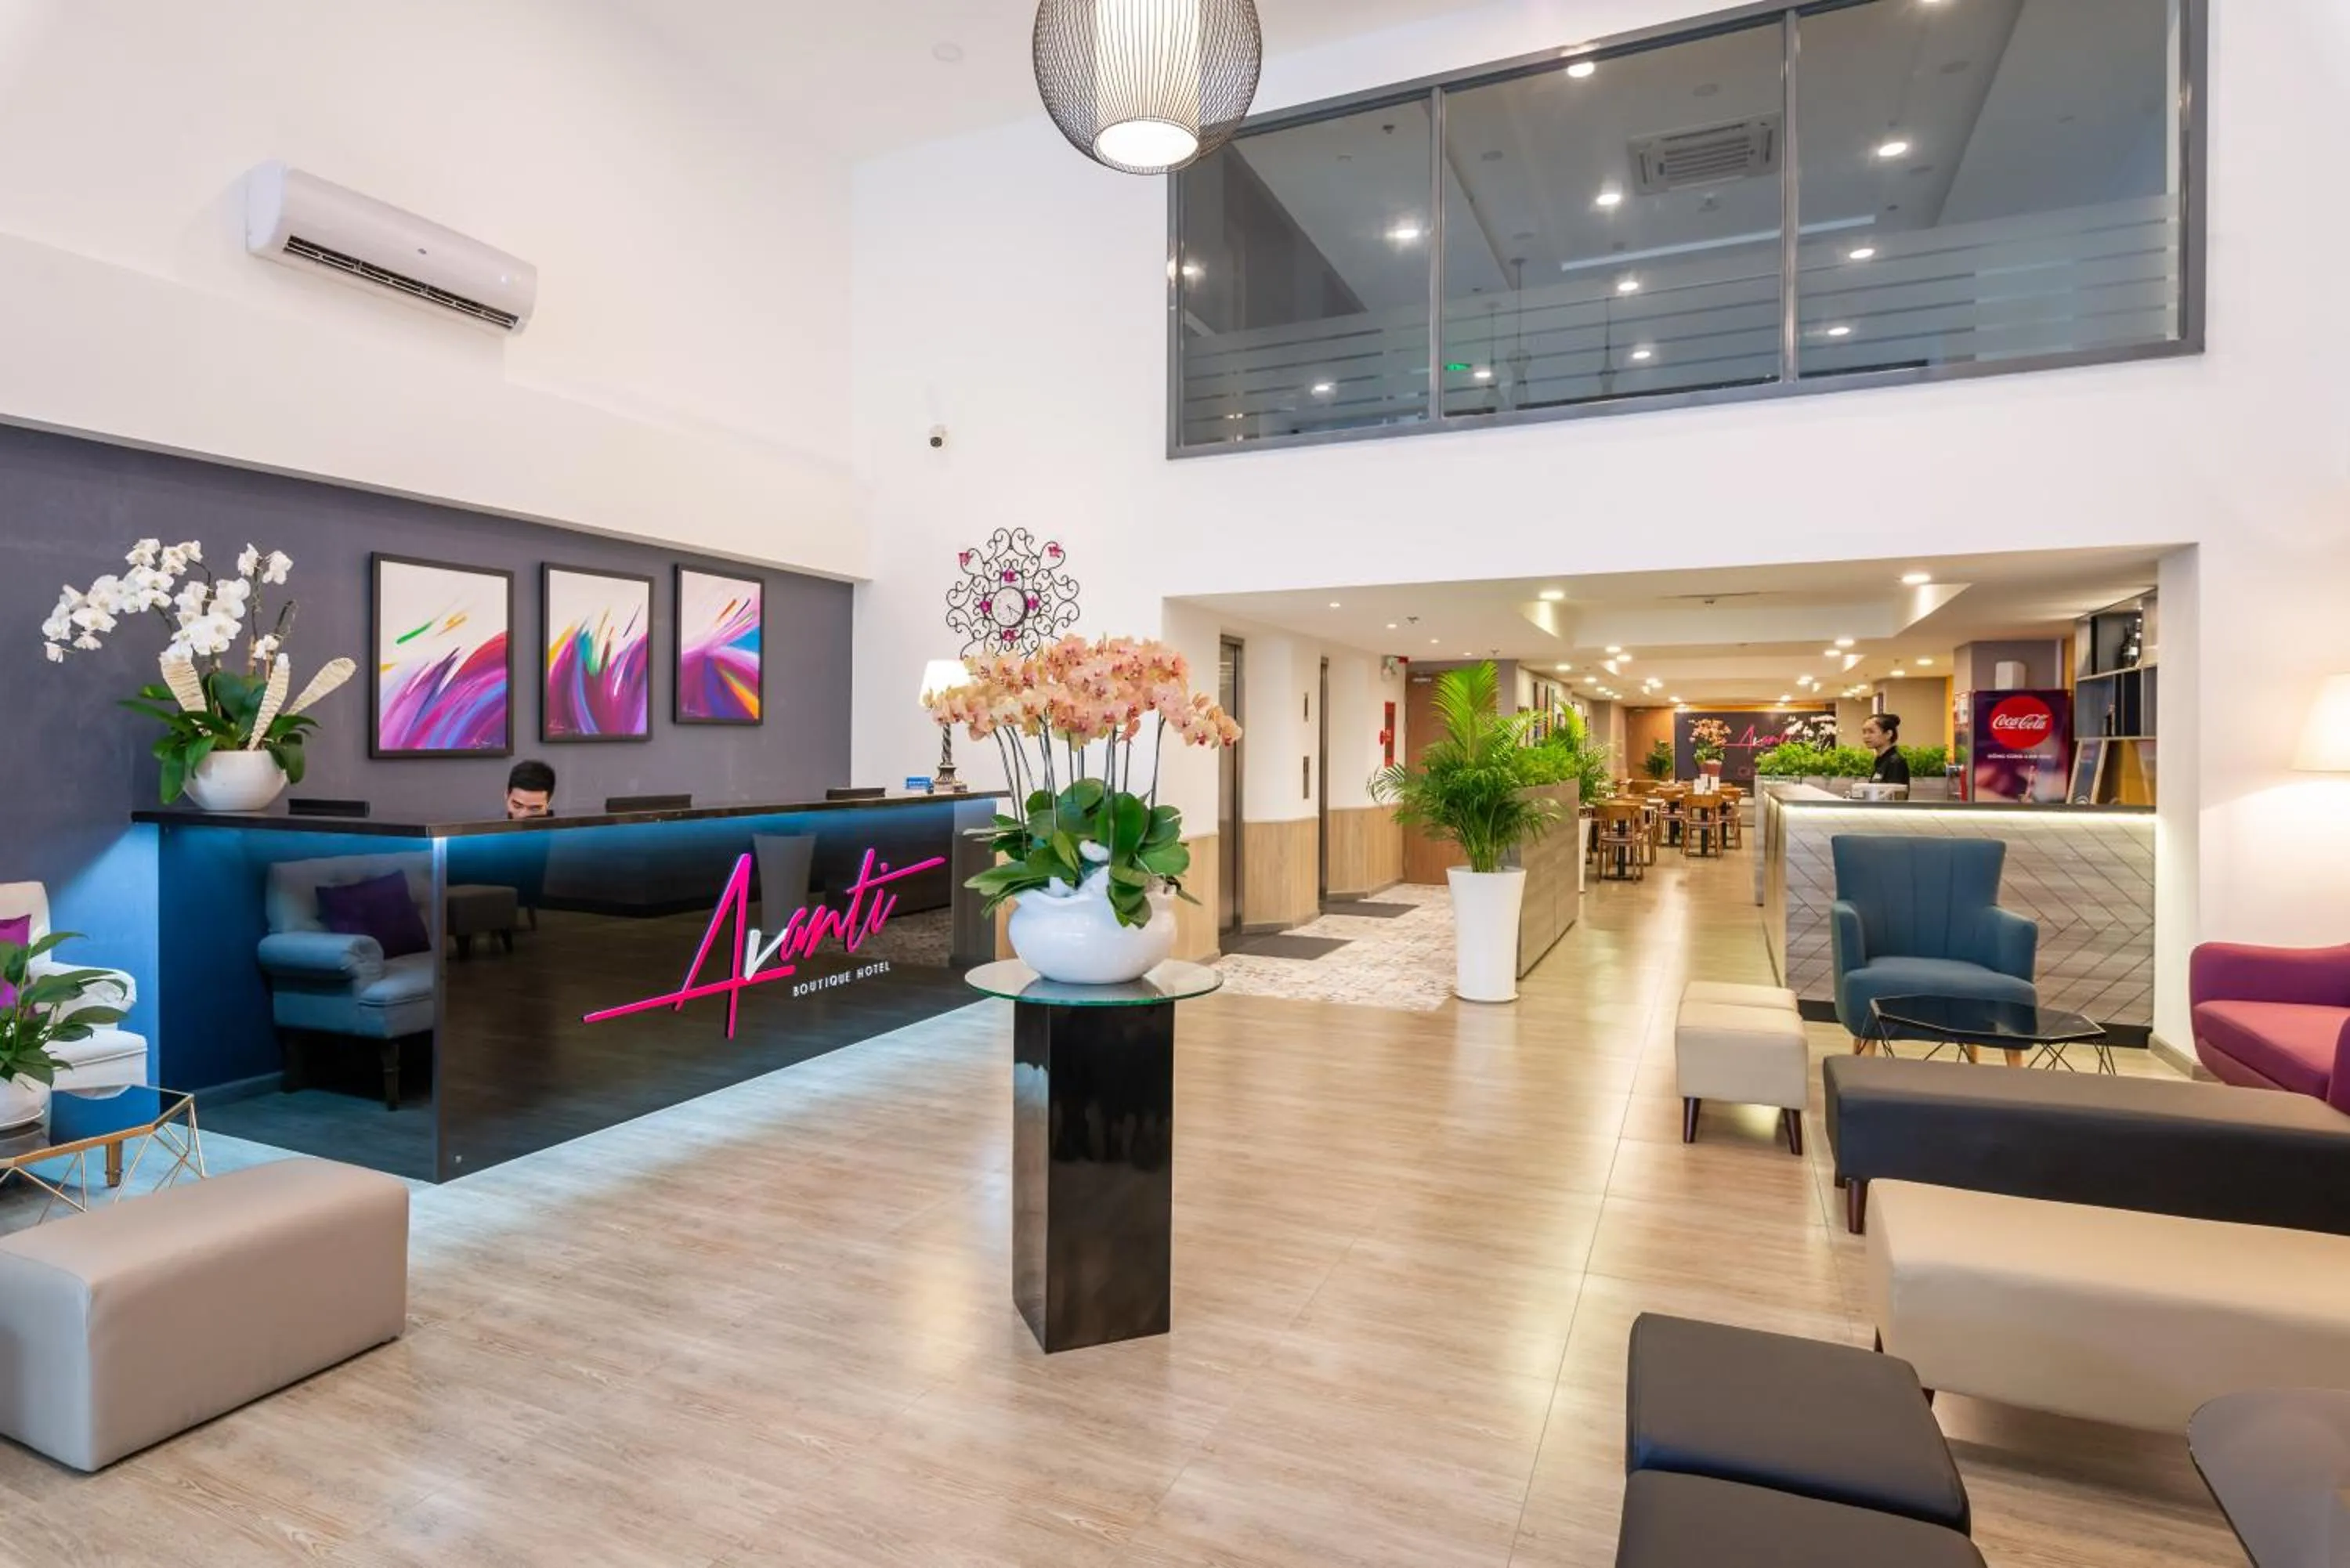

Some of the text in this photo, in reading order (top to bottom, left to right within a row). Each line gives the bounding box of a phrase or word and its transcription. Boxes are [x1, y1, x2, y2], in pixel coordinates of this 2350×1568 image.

[583, 848, 945, 1040] Avanti
[793, 960, 890, 997] BOUTIQUE HOTEL
